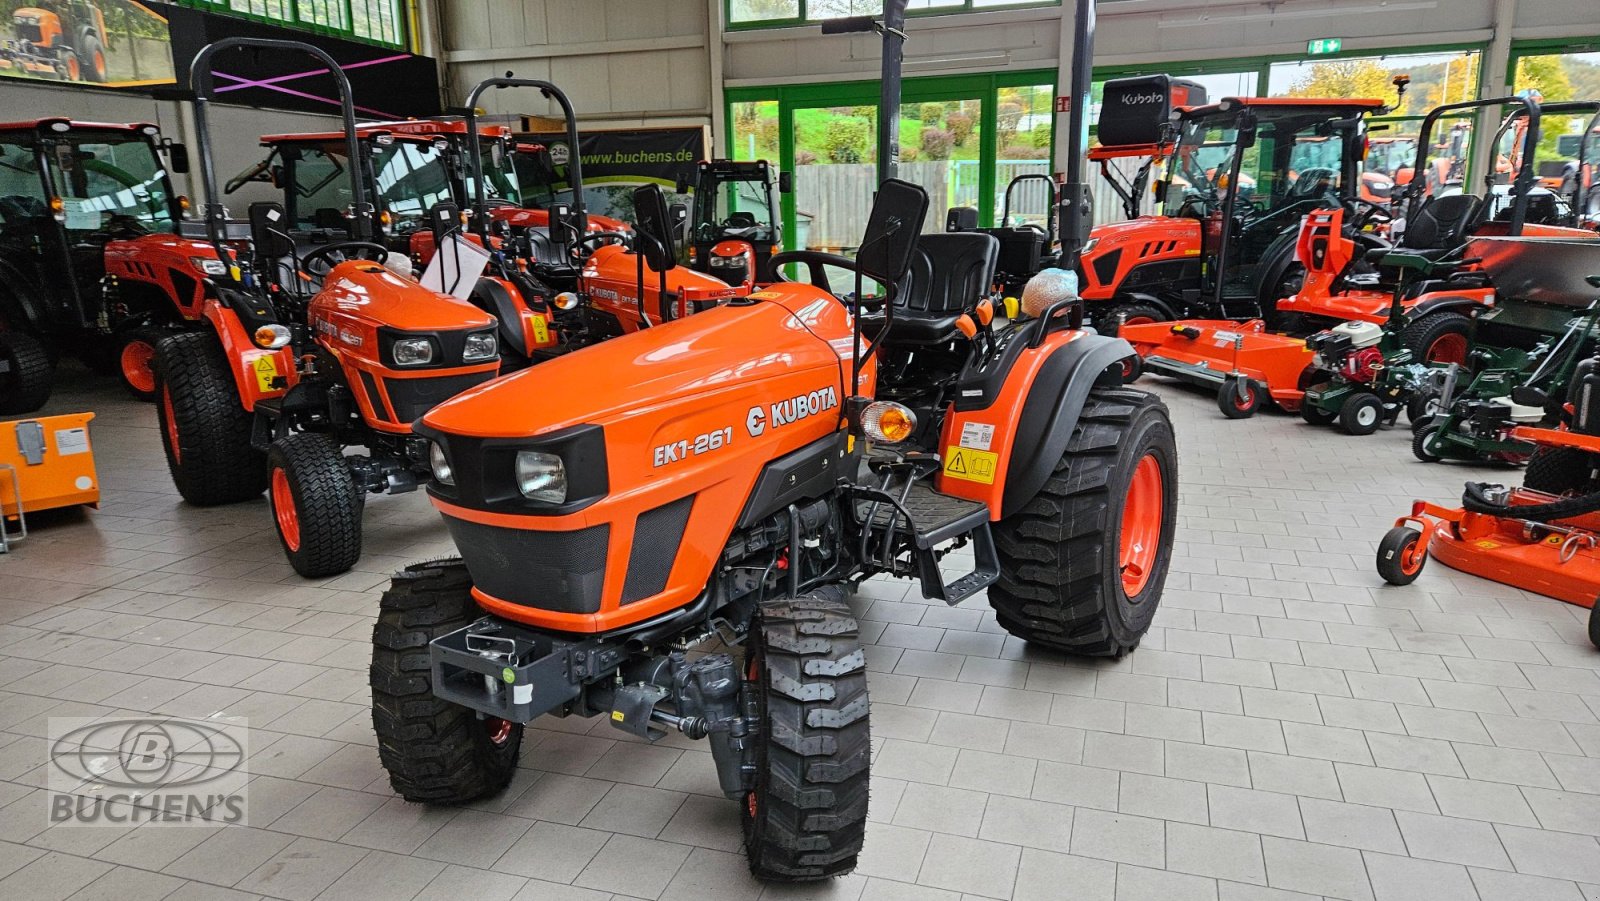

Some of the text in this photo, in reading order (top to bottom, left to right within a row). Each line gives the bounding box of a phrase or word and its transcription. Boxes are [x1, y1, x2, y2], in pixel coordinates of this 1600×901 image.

[1122, 92, 1163, 104] Kubota
[580, 149, 693, 165] www.buchens.de
[771, 385, 838, 428] KUBOTA
[653, 426, 733, 467] EK1-261
